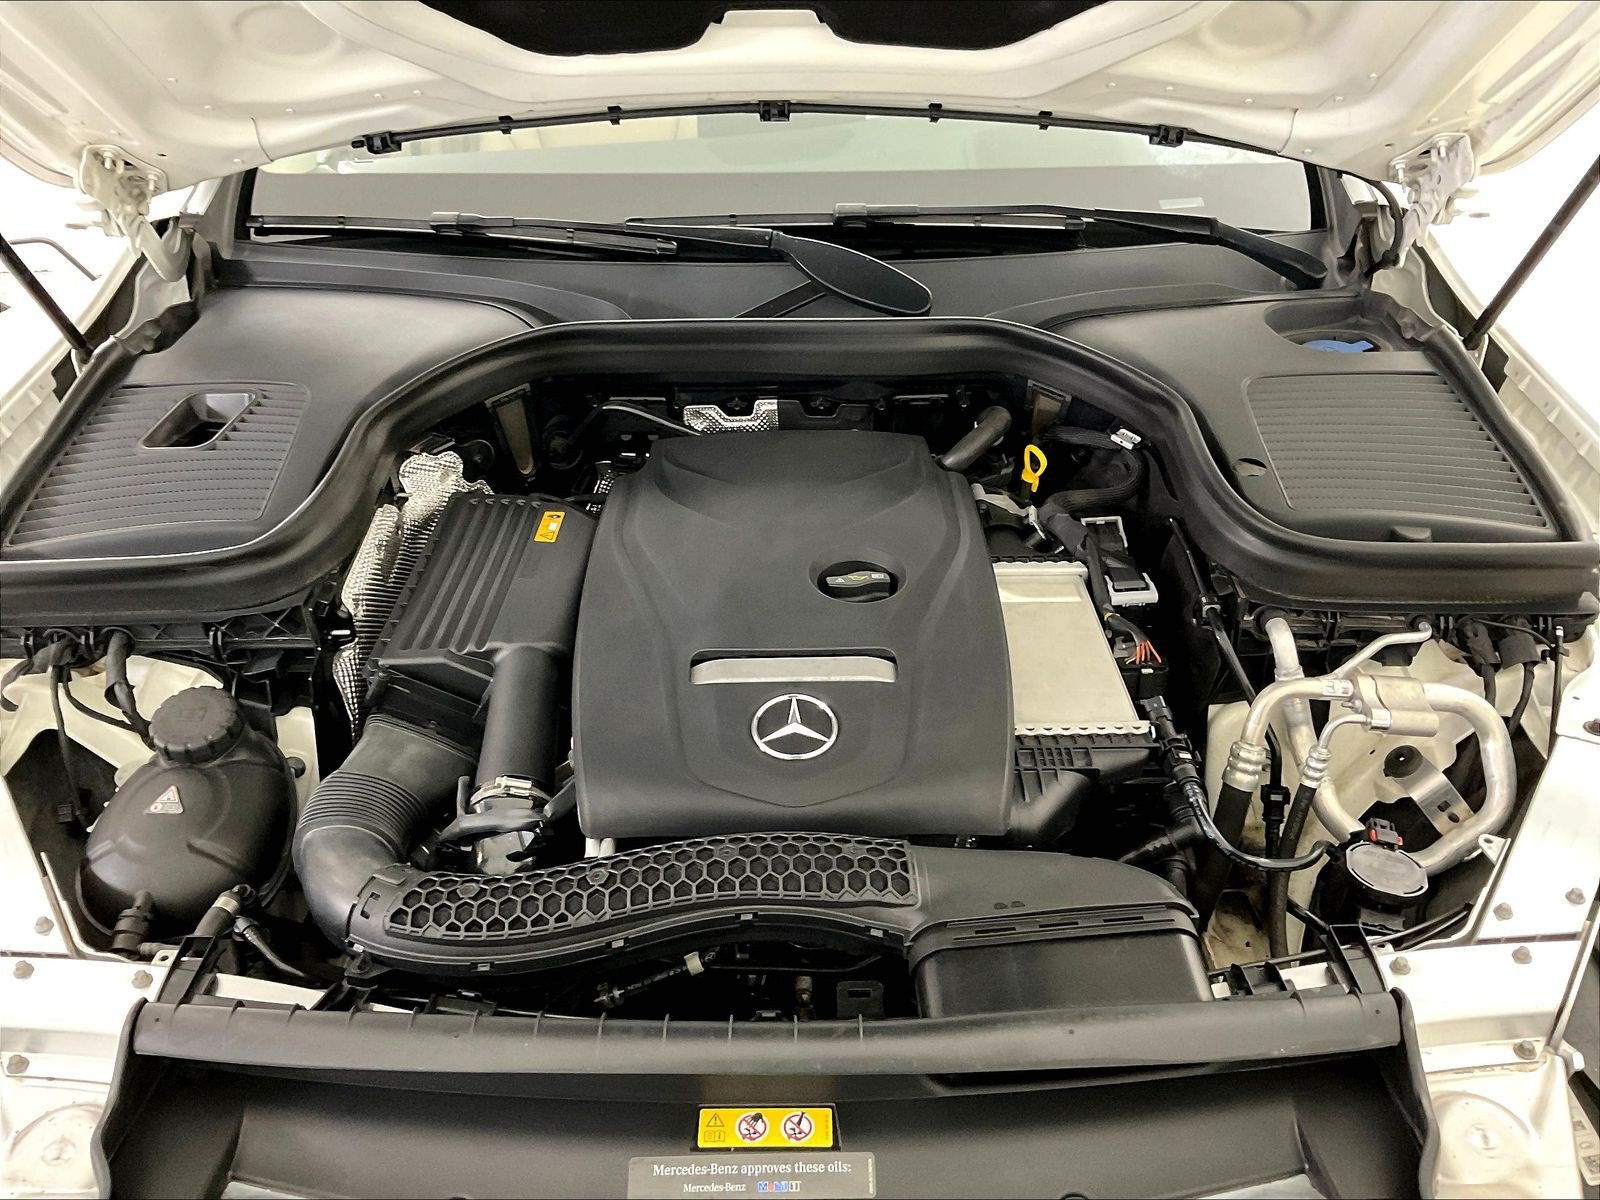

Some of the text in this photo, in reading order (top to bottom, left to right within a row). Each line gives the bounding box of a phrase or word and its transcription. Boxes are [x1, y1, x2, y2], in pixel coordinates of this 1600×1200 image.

[653, 1160, 852, 1176] Mercedes-Benz approves these oils:
[683, 1182, 746, 1193] Mercedes-Benz
